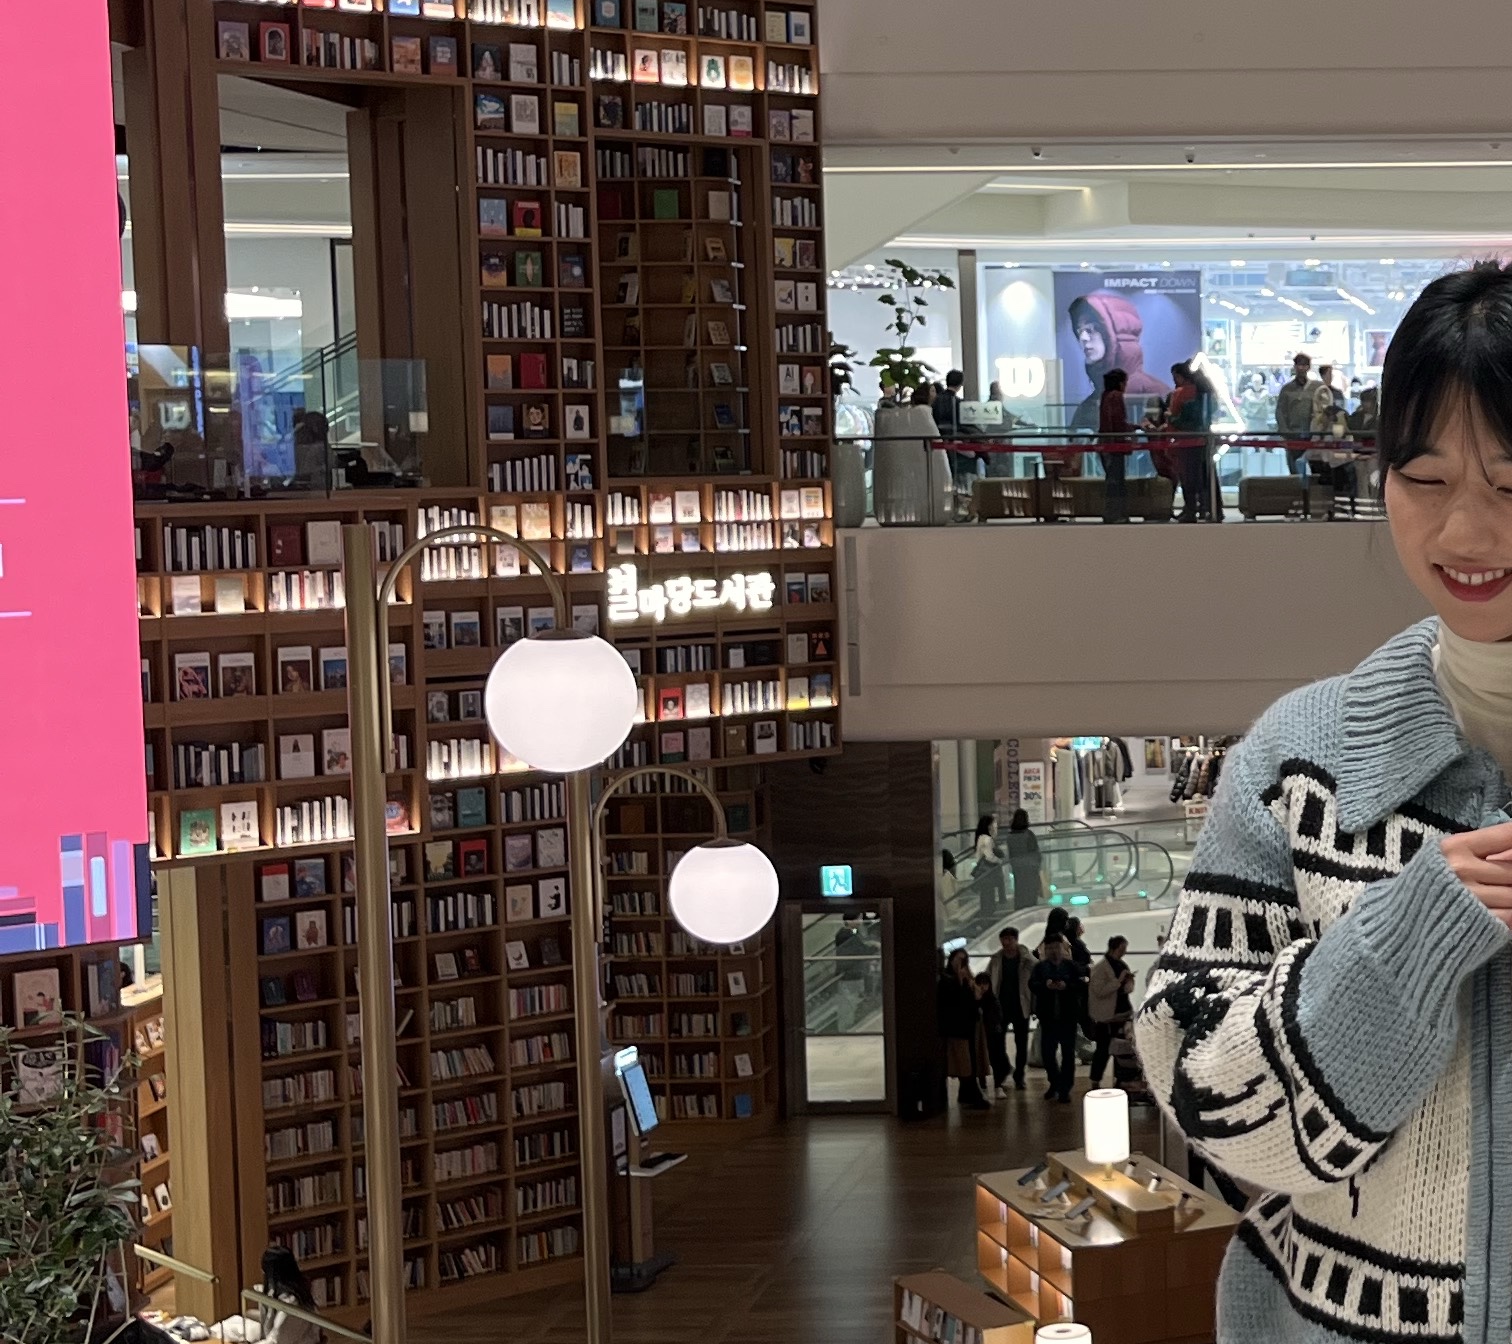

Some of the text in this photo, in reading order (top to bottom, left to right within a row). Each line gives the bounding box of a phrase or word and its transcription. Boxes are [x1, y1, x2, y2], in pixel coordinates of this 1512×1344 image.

[1104, 277, 1196, 288] IMPACT DOWN
[606, 562, 777, 623] 별마당도서관
